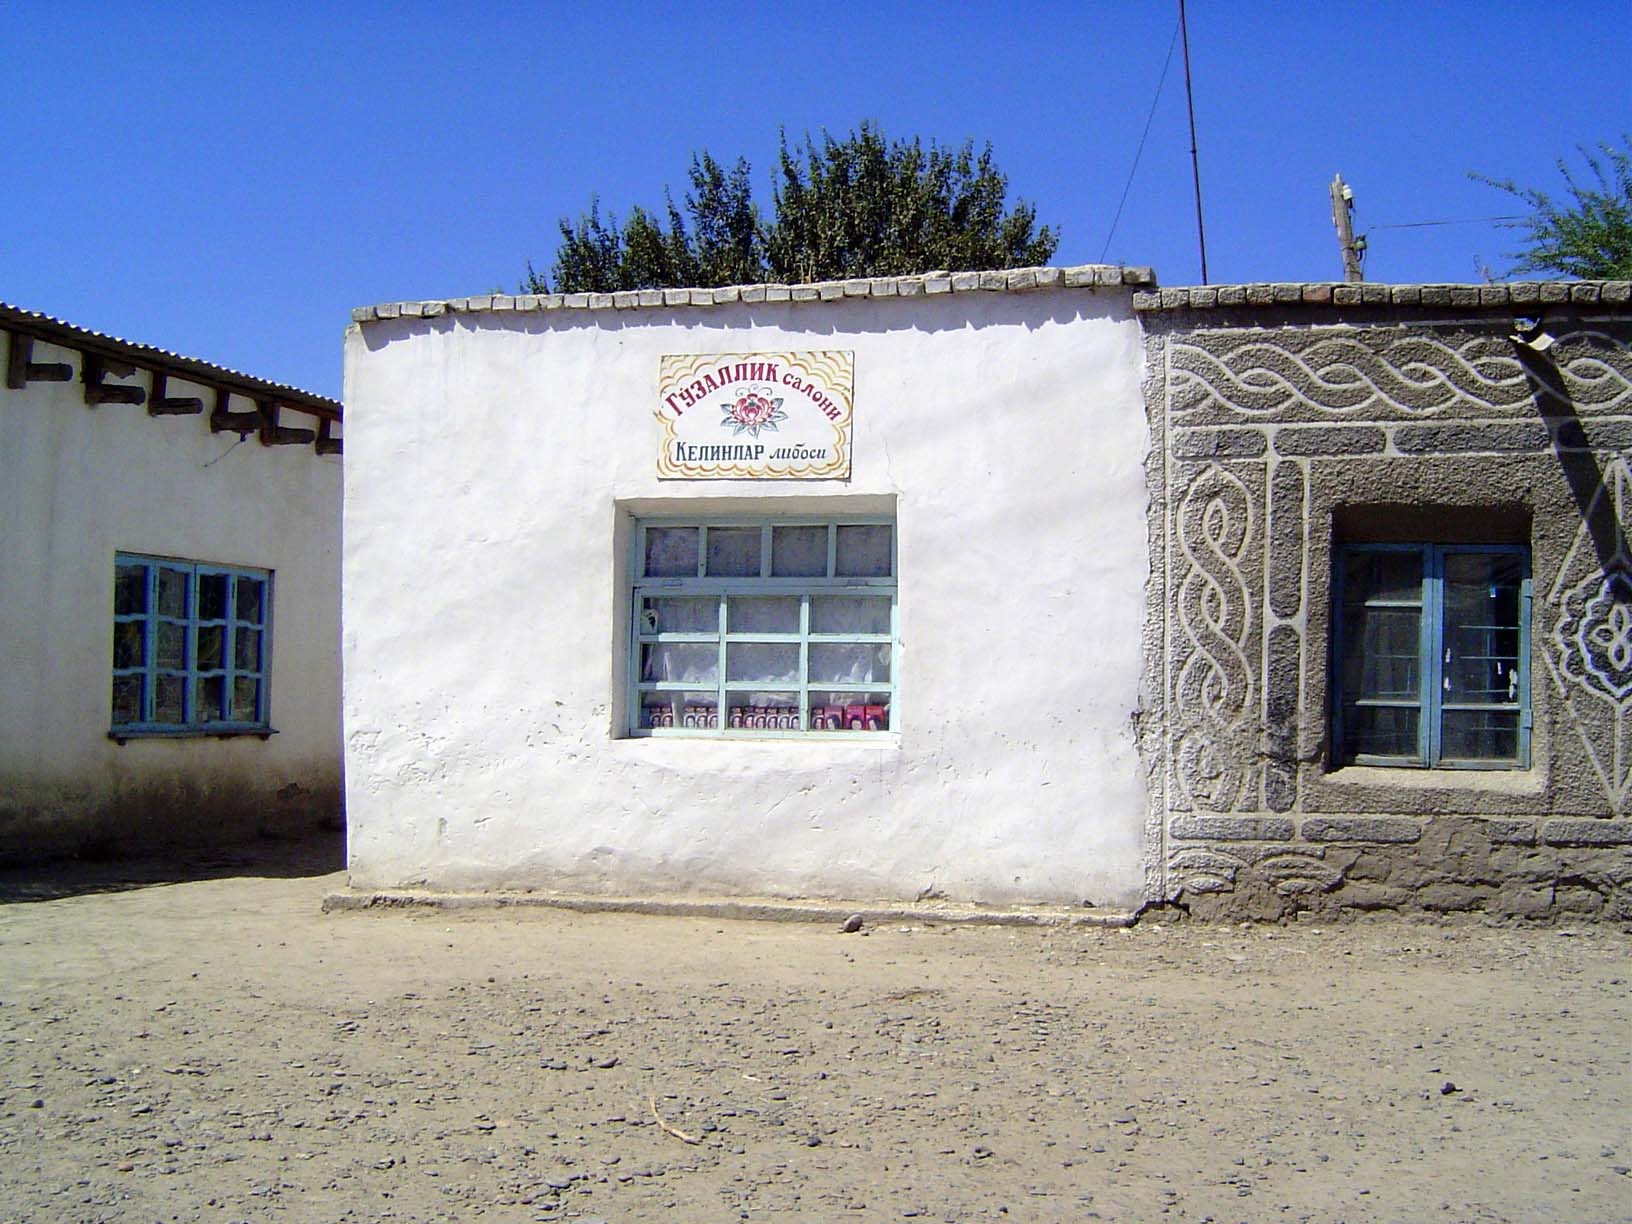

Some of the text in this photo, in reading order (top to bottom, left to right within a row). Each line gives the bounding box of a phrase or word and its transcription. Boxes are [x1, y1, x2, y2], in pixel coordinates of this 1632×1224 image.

[782, 373, 842, 421] салони
[676, 441, 826, 462] КЕЛИНЛАР либоси
